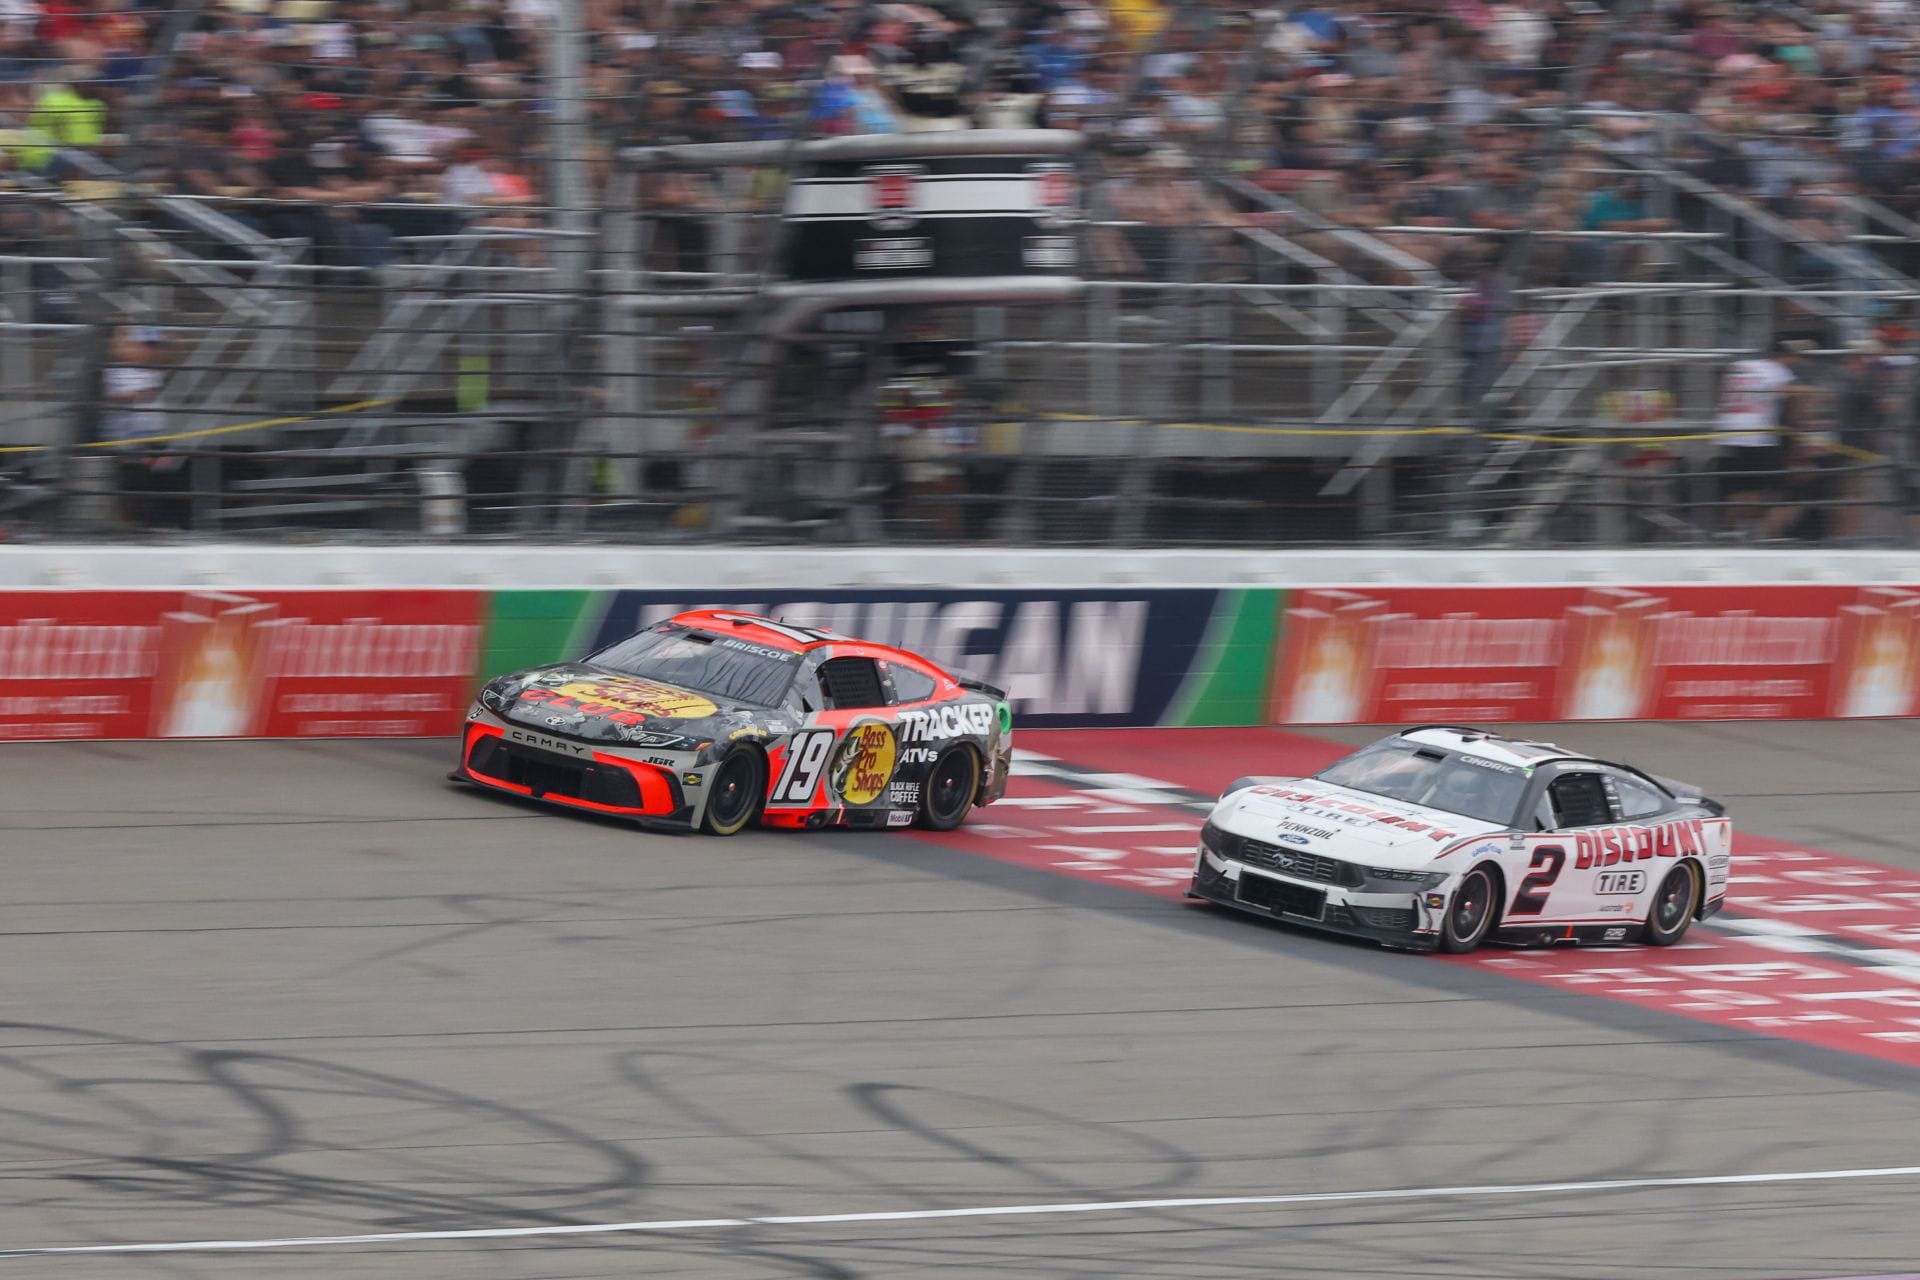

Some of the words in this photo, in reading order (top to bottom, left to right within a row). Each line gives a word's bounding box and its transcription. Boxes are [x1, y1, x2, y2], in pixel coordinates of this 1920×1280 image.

[723, 639, 792, 662] BRISCOE
[519, 689, 646, 726] CLUB
[897, 703, 994, 743] TRACKER
[511, 731, 584, 755] CAMRY
[861, 725, 887, 749] Bass
[642, 756, 675, 768] JGR
[772, 731, 835, 801] 19
[856, 745, 877, 770] Pro
[901, 748, 938, 764] ATVs
[1459, 755, 1516, 774] CINDRIC
[852, 768, 885, 796] Shops
[905, 782, 920, 792] RIFLE
[890, 790, 919, 803] COFFEE
[1249, 785, 1457, 842] DISCOUNT
[1298, 805, 1364, 826] TIRE
[1277, 820, 1335, 841] PENNZOIL
[1574, 819, 1707, 870] DISCOUNT
[1509, 844, 1566, 916] 2
[1599, 871, 1639, 893] TIRE
